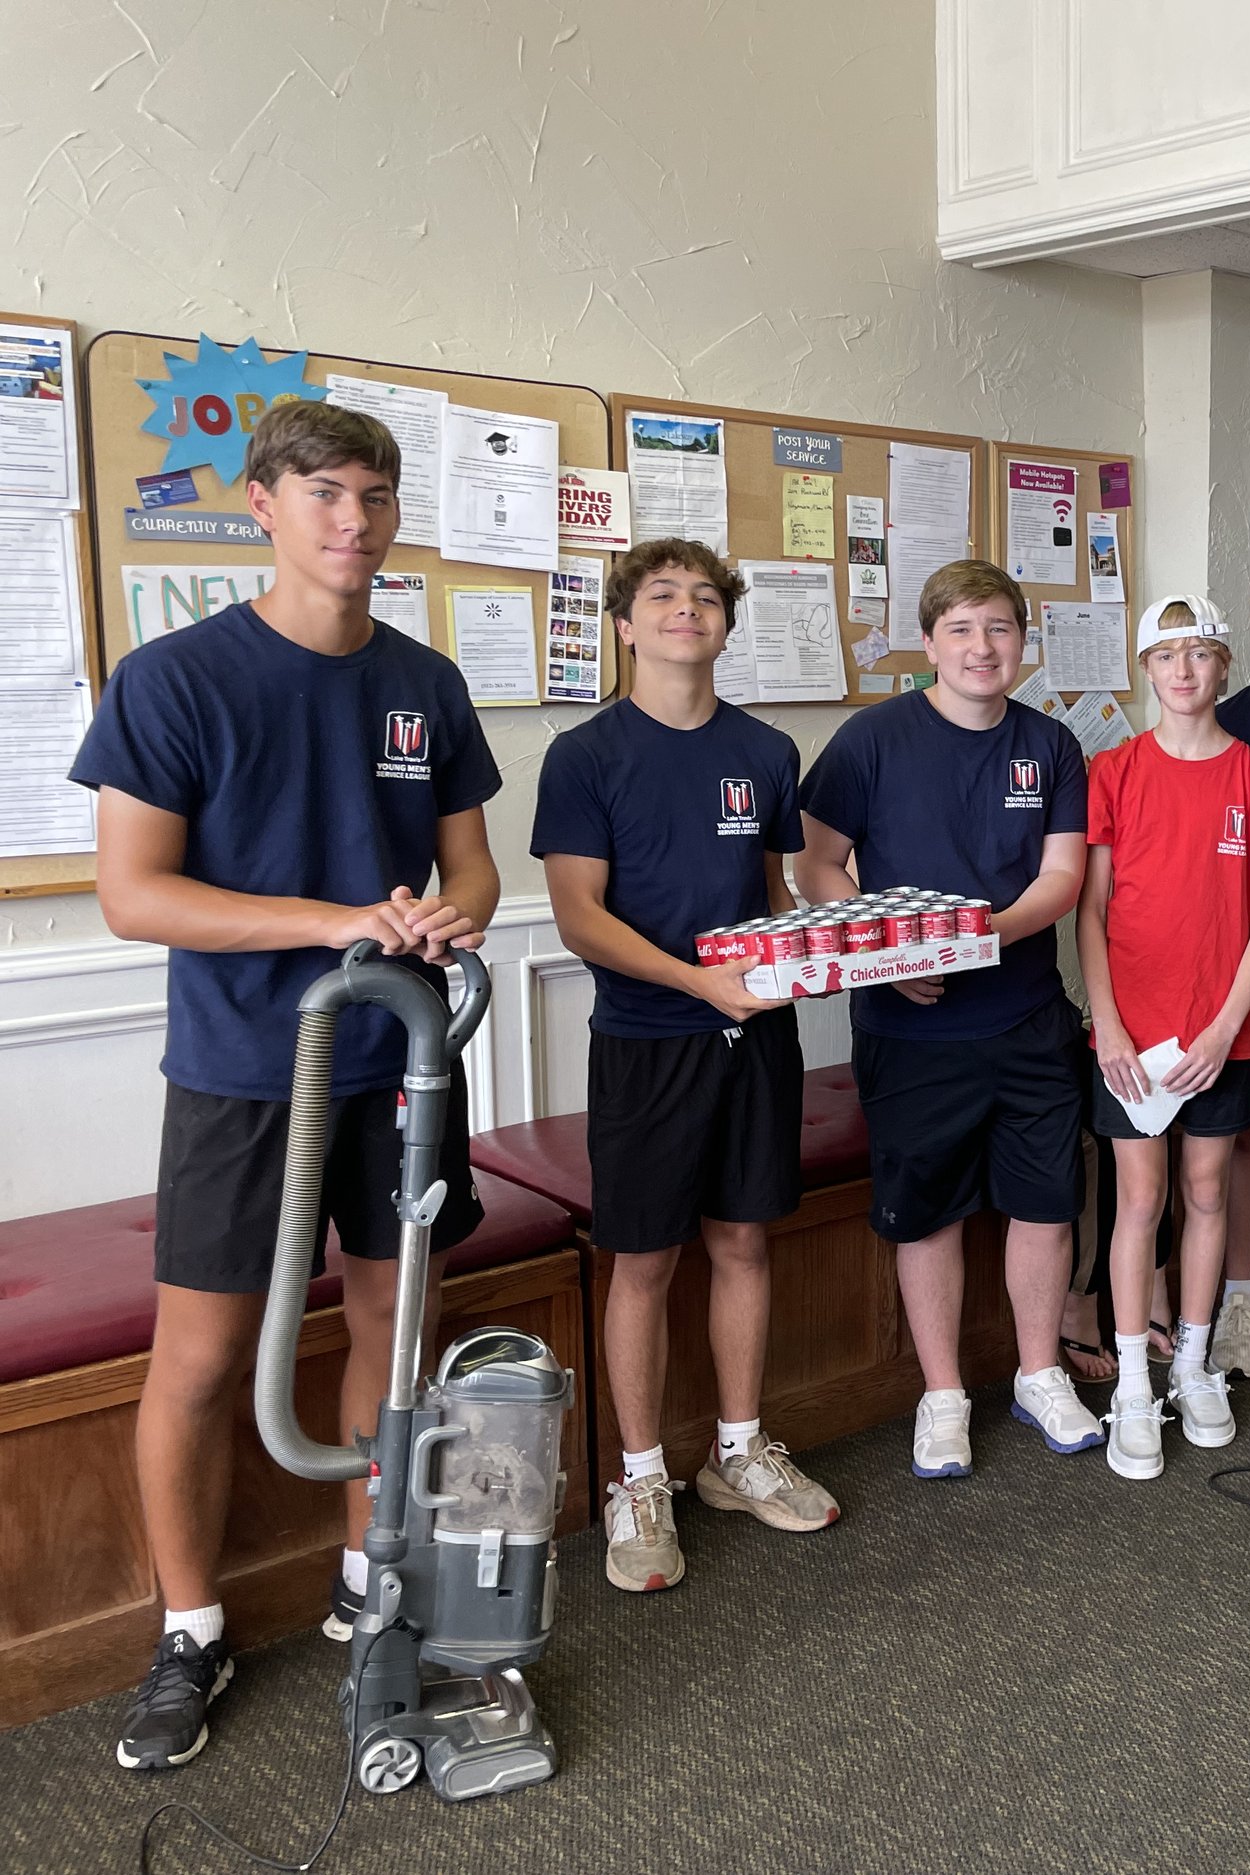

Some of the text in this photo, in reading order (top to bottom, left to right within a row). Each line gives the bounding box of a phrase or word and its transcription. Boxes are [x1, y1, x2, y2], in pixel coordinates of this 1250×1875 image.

[778, 435, 802, 447] POST
[1019, 468, 1066, 481] Mobile Hotspots
[1020, 479, 1064, 490] Now Available!
[377, 763, 431, 773] YOUNG MEN'S
[376, 771, 404, 779] SERVICE
[1218, 842, 1240, 850] YOUNG
[878, 953, 907, 965] Campbell's
[850, 958, 935, 982] Chicken Noodle
